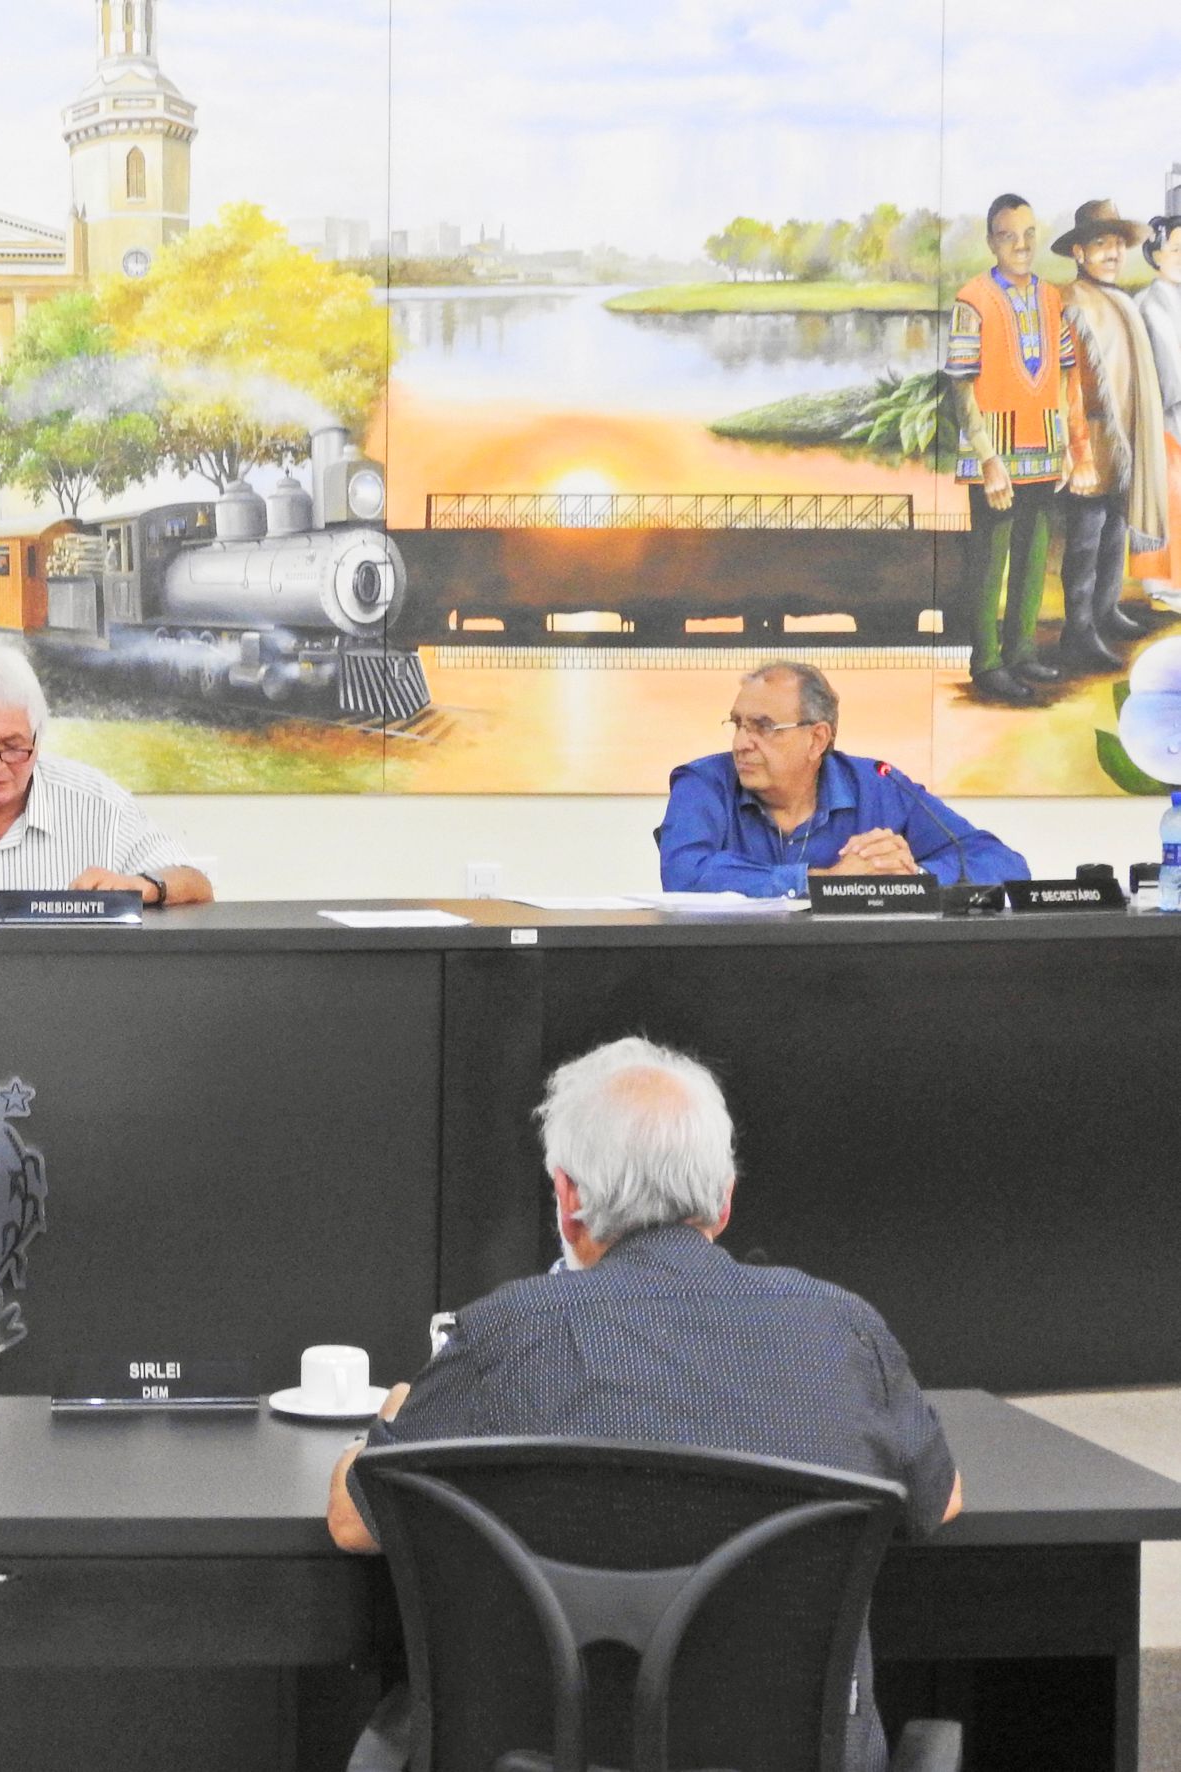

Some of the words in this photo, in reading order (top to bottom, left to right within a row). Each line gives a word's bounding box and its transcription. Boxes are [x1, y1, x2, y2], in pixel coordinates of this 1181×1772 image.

[822, 882, 877, 896] MAURÍCIO
[879, 884, 926, 896] KUSDRA
[1041, 888, 1101, 902] SECRETÁRIO
[30, 901, 105, 914] PRESIDENTE
[129, 1361, 181, 1379] SIRLEI
[142, 1385, 169, 1399] DEM
